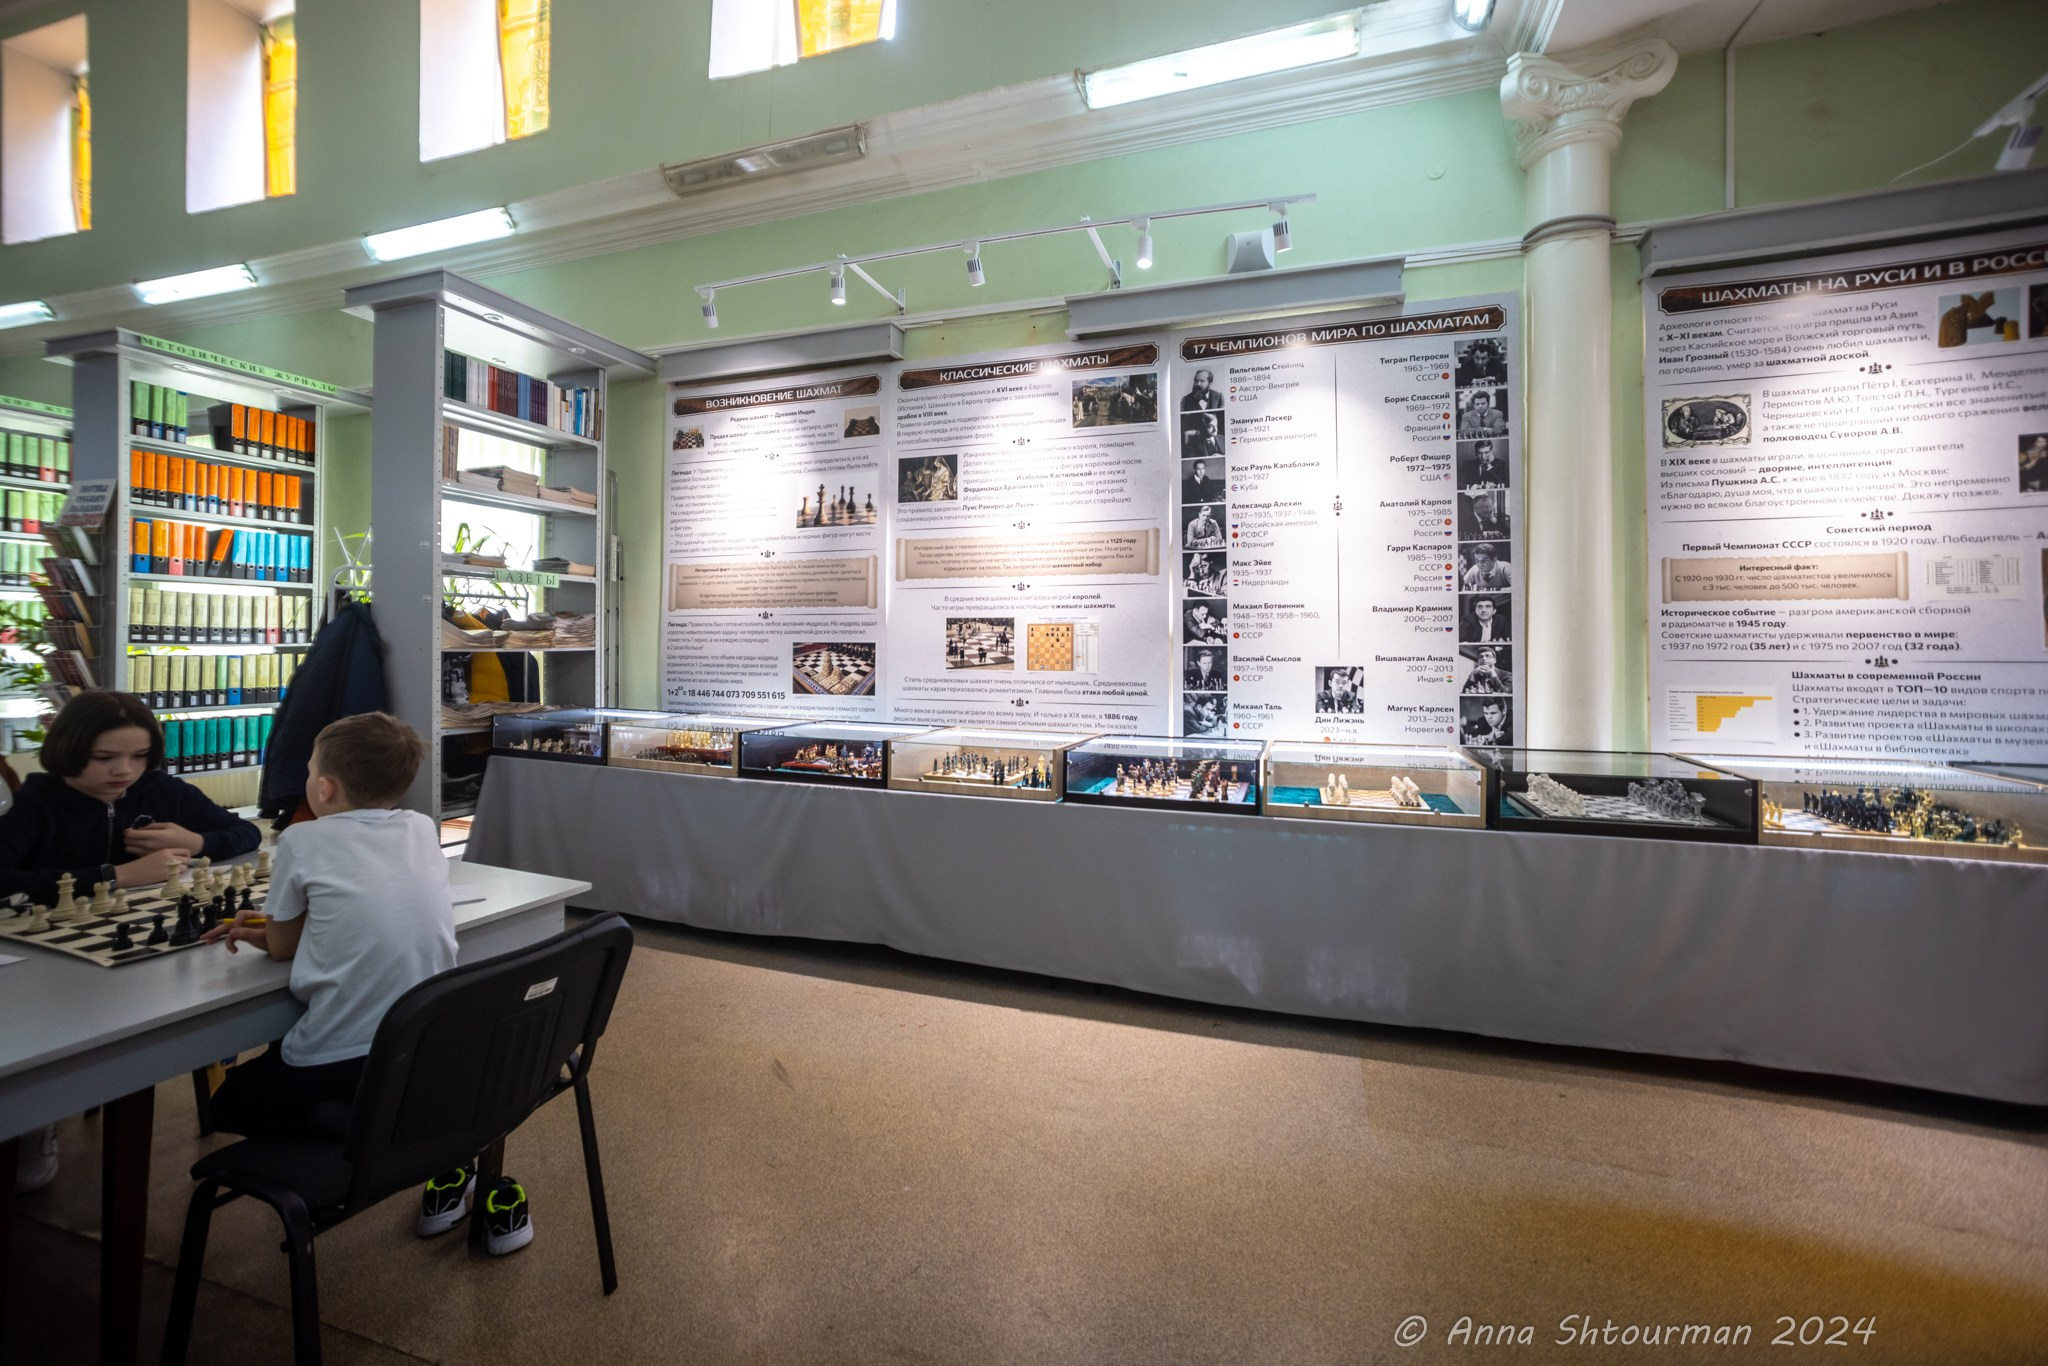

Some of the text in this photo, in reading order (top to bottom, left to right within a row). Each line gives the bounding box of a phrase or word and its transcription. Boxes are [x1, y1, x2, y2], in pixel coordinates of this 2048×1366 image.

[1701, 280, 1810, 304] ШАХМАТЫ
[1818, 276, 1848, 291] НА
[1855, 267, 1916, 287] РУСИ
[1924, 264, 1940, 278] И
[1950, 261, 1965, 276] В
[1193, 313, 1489, 354] 17 ЧЕМПИОНОВ МИРА ПО ШАХМАТАМ
[1659, 345, 1686, 353] через
[1688, 340, 1746, 350] Каспийское
[1748, 337, 1775, 345] море
[1785, 330, 1839, 342] Волжский
[1841, 324, 1895, 337] торговый
[1410, 354, 1449, 362] Петросян
[1659, 351, 1729, 364] Иван Грозный
[1727, 362, 1752, 371] умер
[1766, 354, 1827, 366] шахматной
[142, 336, 336, 392] МЕТОДИЧЕСКИЕ ЖУРНАЛЫ
[939, 362, 1037, 381] КЛАССИЧЕСКИЕ
[1229, 366, 1271, 374] Вильгельм
[1416, 373, 1440, 381] СССР
[705, 384, 843, 409] ВОЗНИКНОВЕНИЕ ШАХМАТ
[1384, 392, 1450, 404] Борис Спасский
[1230, 417, 1264, 425] Эмануил
[1404, 425, 1441, 433] Франция
[1412, 434, 1441, 442] Россия
[1763, 434, 1828, 442] полководец
[1830, 431, 1878, 439] Суворов
[1389, 453, 1451, 463] Роберт Фишер
[1250, 463, 1273, 471] Рауль
[1274, 461, 1320, 469] Капабланка
[1711, 475, 1781, 487] Пушкина А.С.
[1379, 498, 1452, 507] Анатолий Карпов
[1826, 525, 1932, 534] Советский период
[1386, 543, 1452, 552] Гарри Каспаров
[1682, 540, 1812, 552] Первый Чемпионат СССР
[1739, 563, 1819, 572] Интересный факт:
[496, 570, 555, 586] ГАЗЕТЫ
[1404, 585, 1443, 593] Хорватия
[1372, 605, 1453, 613] Владимир Крамник
[1661, 606, 1971, 618] Историческое событие разгром американской сборной
[1669, 621, 1727, 629] радиоматче
[1736, 619, 1760, 627] 1945
[1661, 631, 1712, 639] Советские
[1779, 632, 1844, 640] удерживали
[1845, 632, 1912, 640] первенство
[1669, 642, 1690, 650] 1937
[1707, 642, 1728, 650] 1972
[1730, 643, 1748, 651] год
[1750, 642, 1767, 651] (35
[1768, 642, 1791, 651] лет)
[1809, 642, 1834, 650] 1975
[1851, 642, 1880, 650] 2007
[1882, 643, 1902, 651] год
[1904, 642, 1924, 651] (32
[1427, 654, 1454, 662] Ананд
[1417, 675, 1444, 683] Индия
[1791, 671, 1845, 679] Шахматы
[1856, 672, 1935, 681] современной
[1937, 672, 1981, 680] России
[688, 688, 696, 696] 18
[697, 689, 711, 697] 446
[711, 689, 725, 697] 744
[726, 690, 740, 698] 073
[741, 690, 756, 698] 709
[757, 691, 771, 699] 551
[772, 691, 785, 699] 615
[1792, 684, 1844, 692] Шахматы
[1846, 686, 1885, 694] входят
[1951, 687, 1988, 695] видов
[1991, 688, 2035, 696] спорта
[1792, 695, 1880, 704] Стратегические
[1882, 698, 1910, 706] цели
[1922, 699, 1967, 707] задачи:
[1387, 705, 1455, 713] Магнус Карлсен
[1315, 716, 1331, 724] Дин
[1405, 726, 1445, 734] Норвегия
